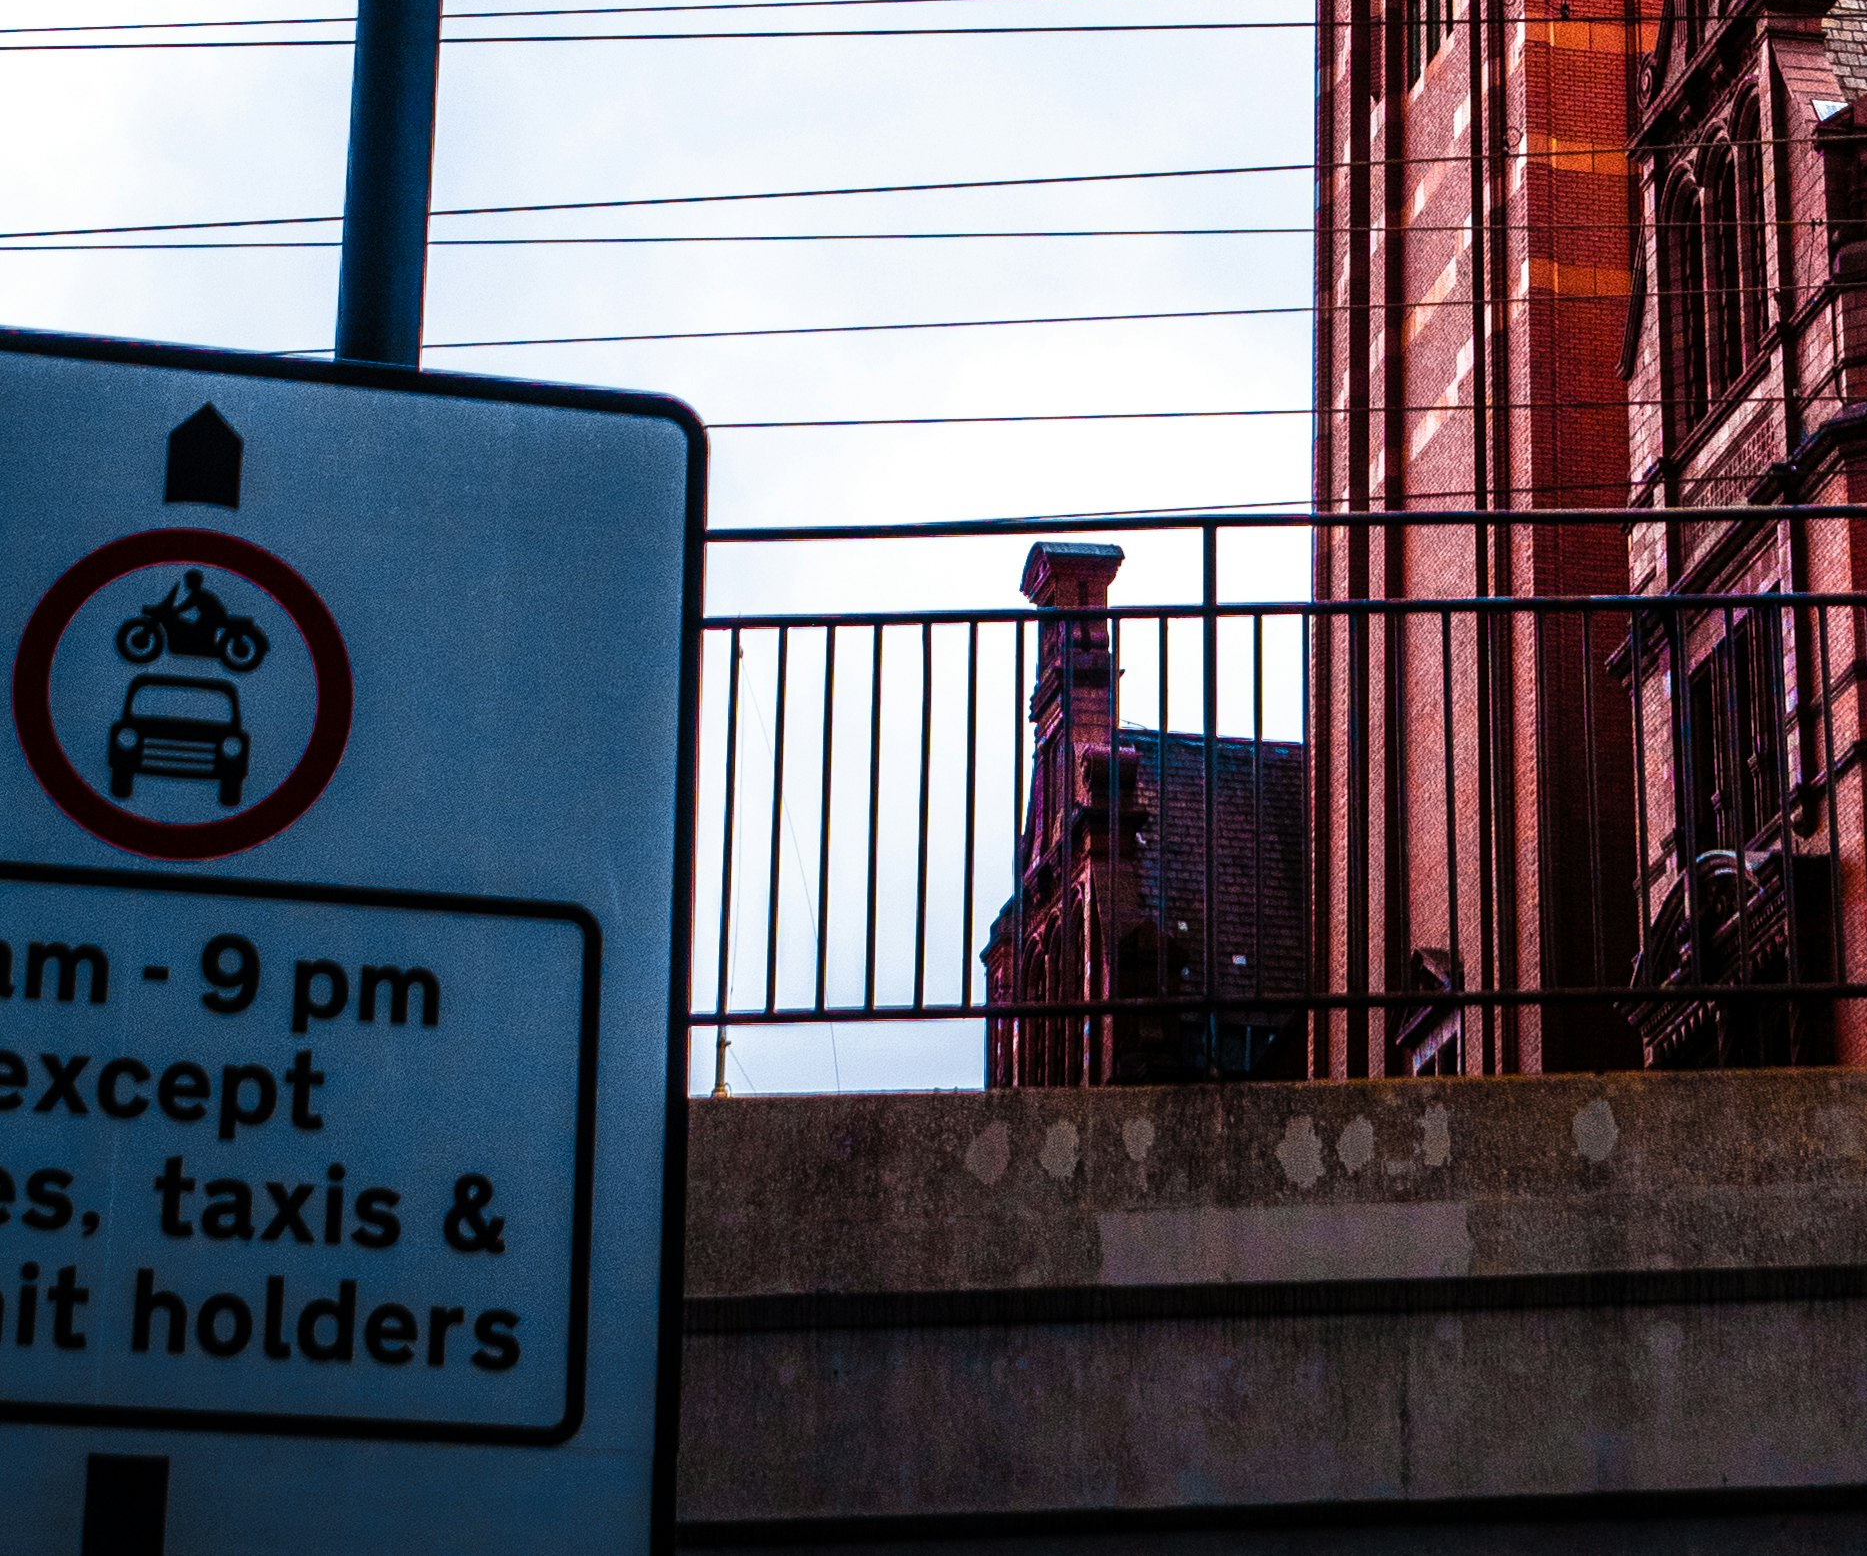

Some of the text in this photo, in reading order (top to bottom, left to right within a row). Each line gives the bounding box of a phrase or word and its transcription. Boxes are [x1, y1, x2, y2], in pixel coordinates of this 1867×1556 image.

[0, 942, 109, 1005] m
[202, 933, 260, 1014] 9
[292, 959, 440, 1034] pm
[0, 1049, 324, 1140] except
[155, 1155, 400, 1249] taxis
[443, 1173, 505, 1254] &
[0, 1261, 521, 1371] it holders
